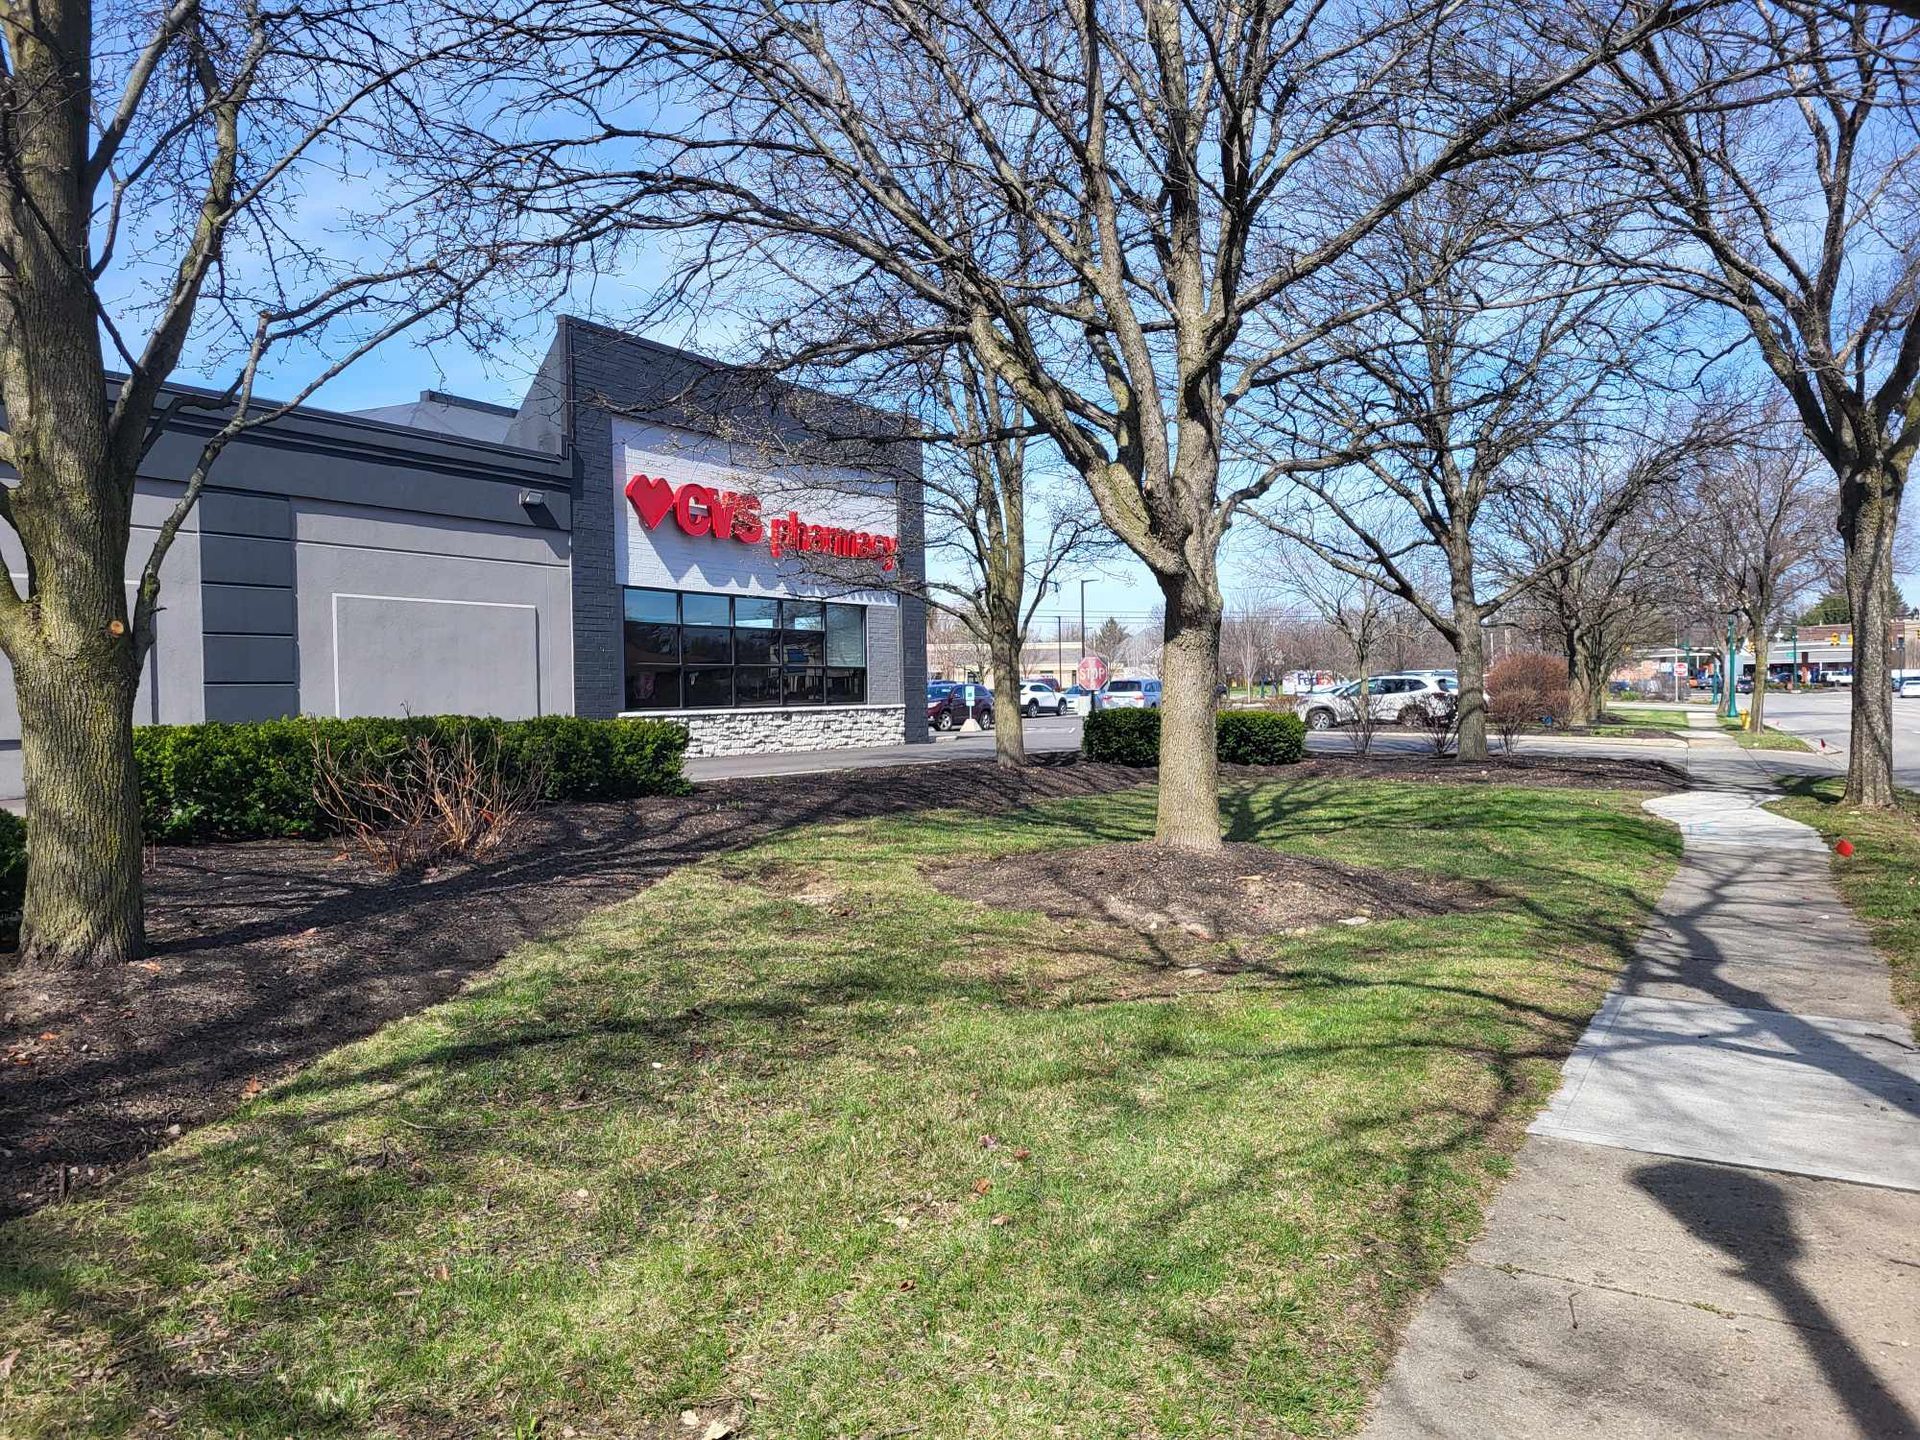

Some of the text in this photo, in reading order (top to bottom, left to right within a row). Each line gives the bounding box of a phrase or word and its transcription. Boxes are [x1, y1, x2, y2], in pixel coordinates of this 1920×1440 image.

[674, 483, 898, 571] CVS pharmacy
[1079, 667, 1105, 680] STOP
